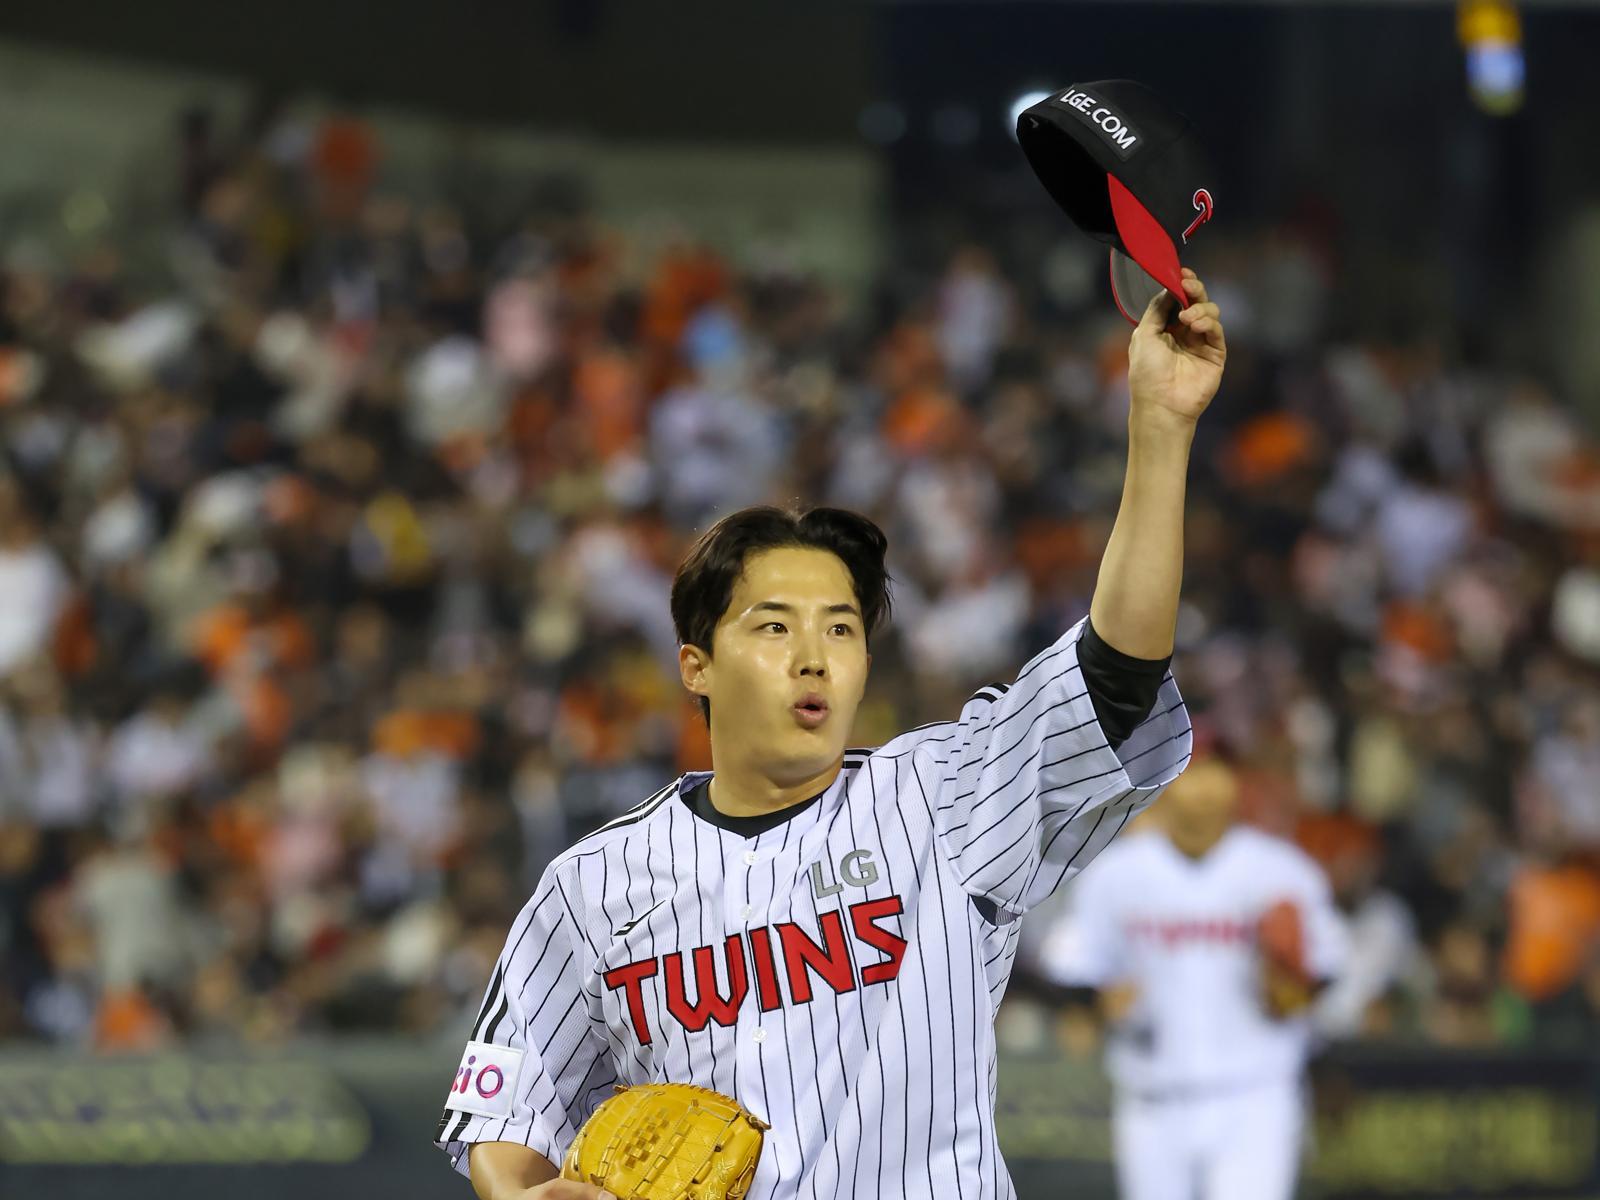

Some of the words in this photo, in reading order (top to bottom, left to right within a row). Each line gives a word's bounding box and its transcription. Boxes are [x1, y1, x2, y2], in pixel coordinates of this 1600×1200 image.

[1060, 89, 1137, 150] LGE.COM
[811, 849, 880, 899] LG
[602, 894, 908, 1046] TWINS
